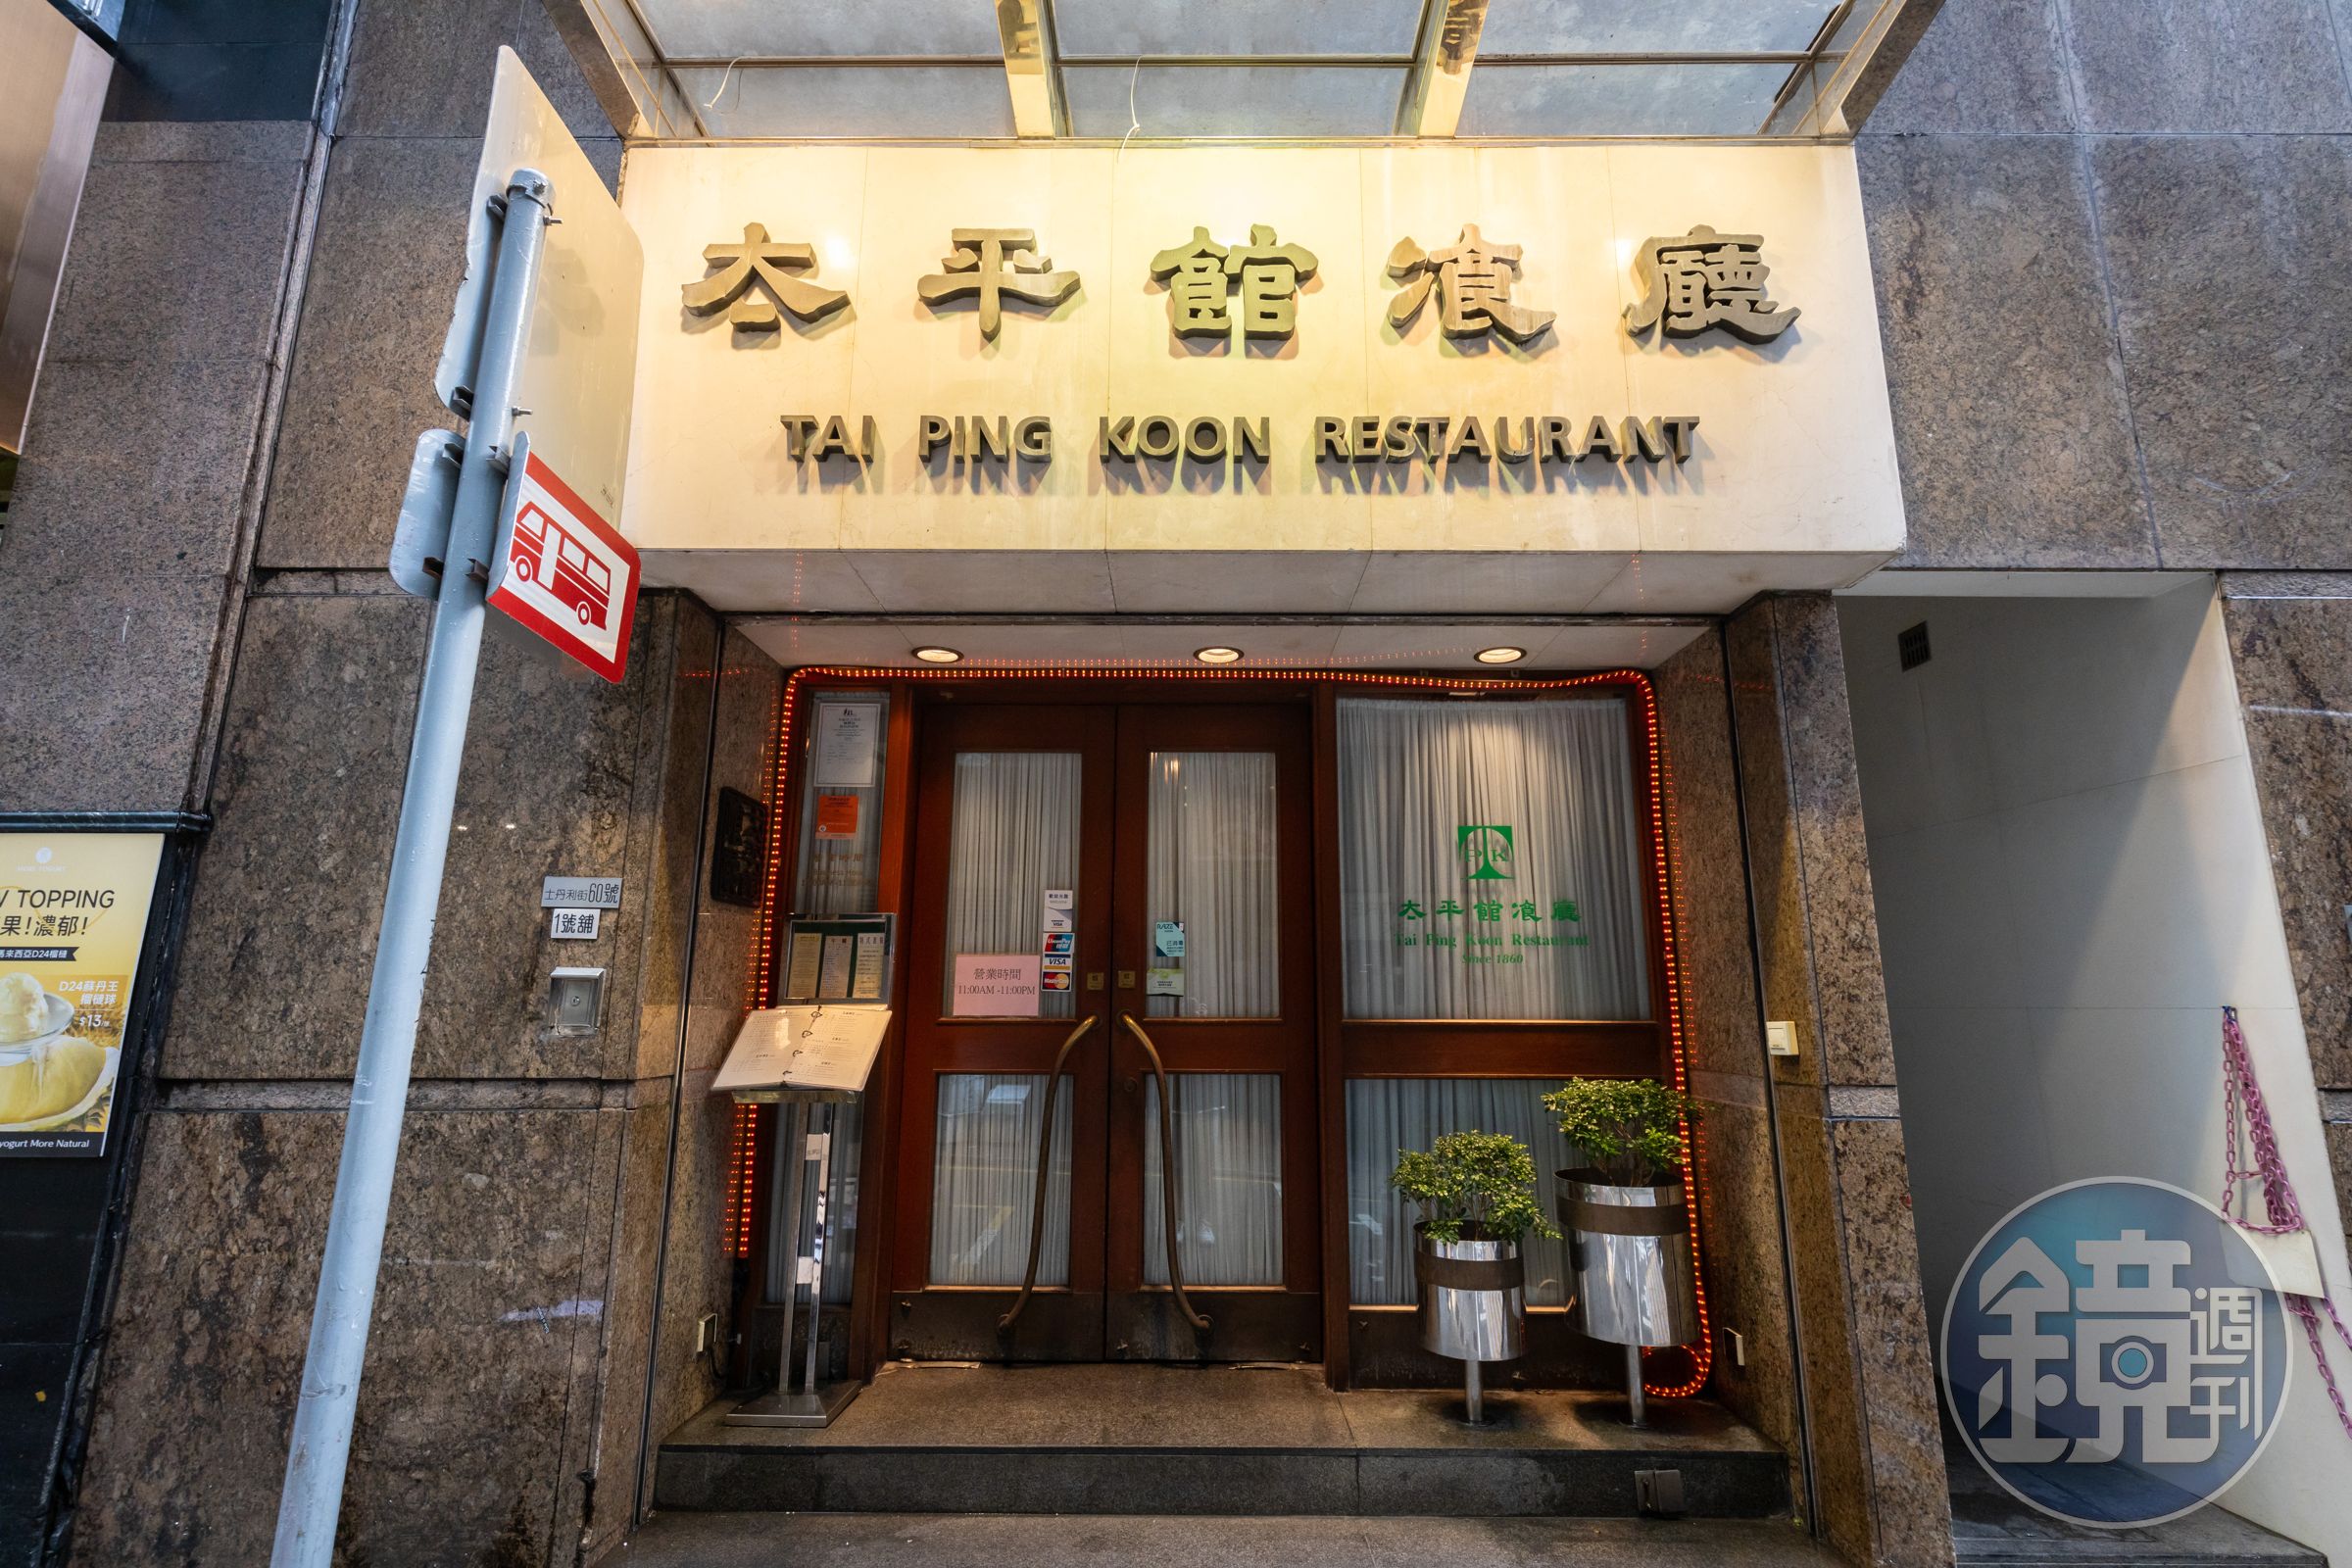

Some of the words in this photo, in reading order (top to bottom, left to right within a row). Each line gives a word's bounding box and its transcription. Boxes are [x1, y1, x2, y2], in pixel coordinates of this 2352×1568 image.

[780, 415, 875, 463] TAI
[918, 415, 1053, 463] PING
[1099, 415, 1271, 464] KOON
[1314, 415, 1701, 465] RESTAURANT
[17, 889, 116, 909] TOPPING
[1395, 933, 1417, 947] Tai
[1426, 933, 1457, 949] Ping
[1465, 933, 1502, 947] Koon
[1512, 933, 1590, 947] Restaurant
[1461, 954, 1492, 964] Since
[973, 968, 1021, 981] 營業時間
[957, 984, 995, 996] 11:00AM
[29, 1138, 55, 1148] More
[56, 1138, 90, 1148] Natural
